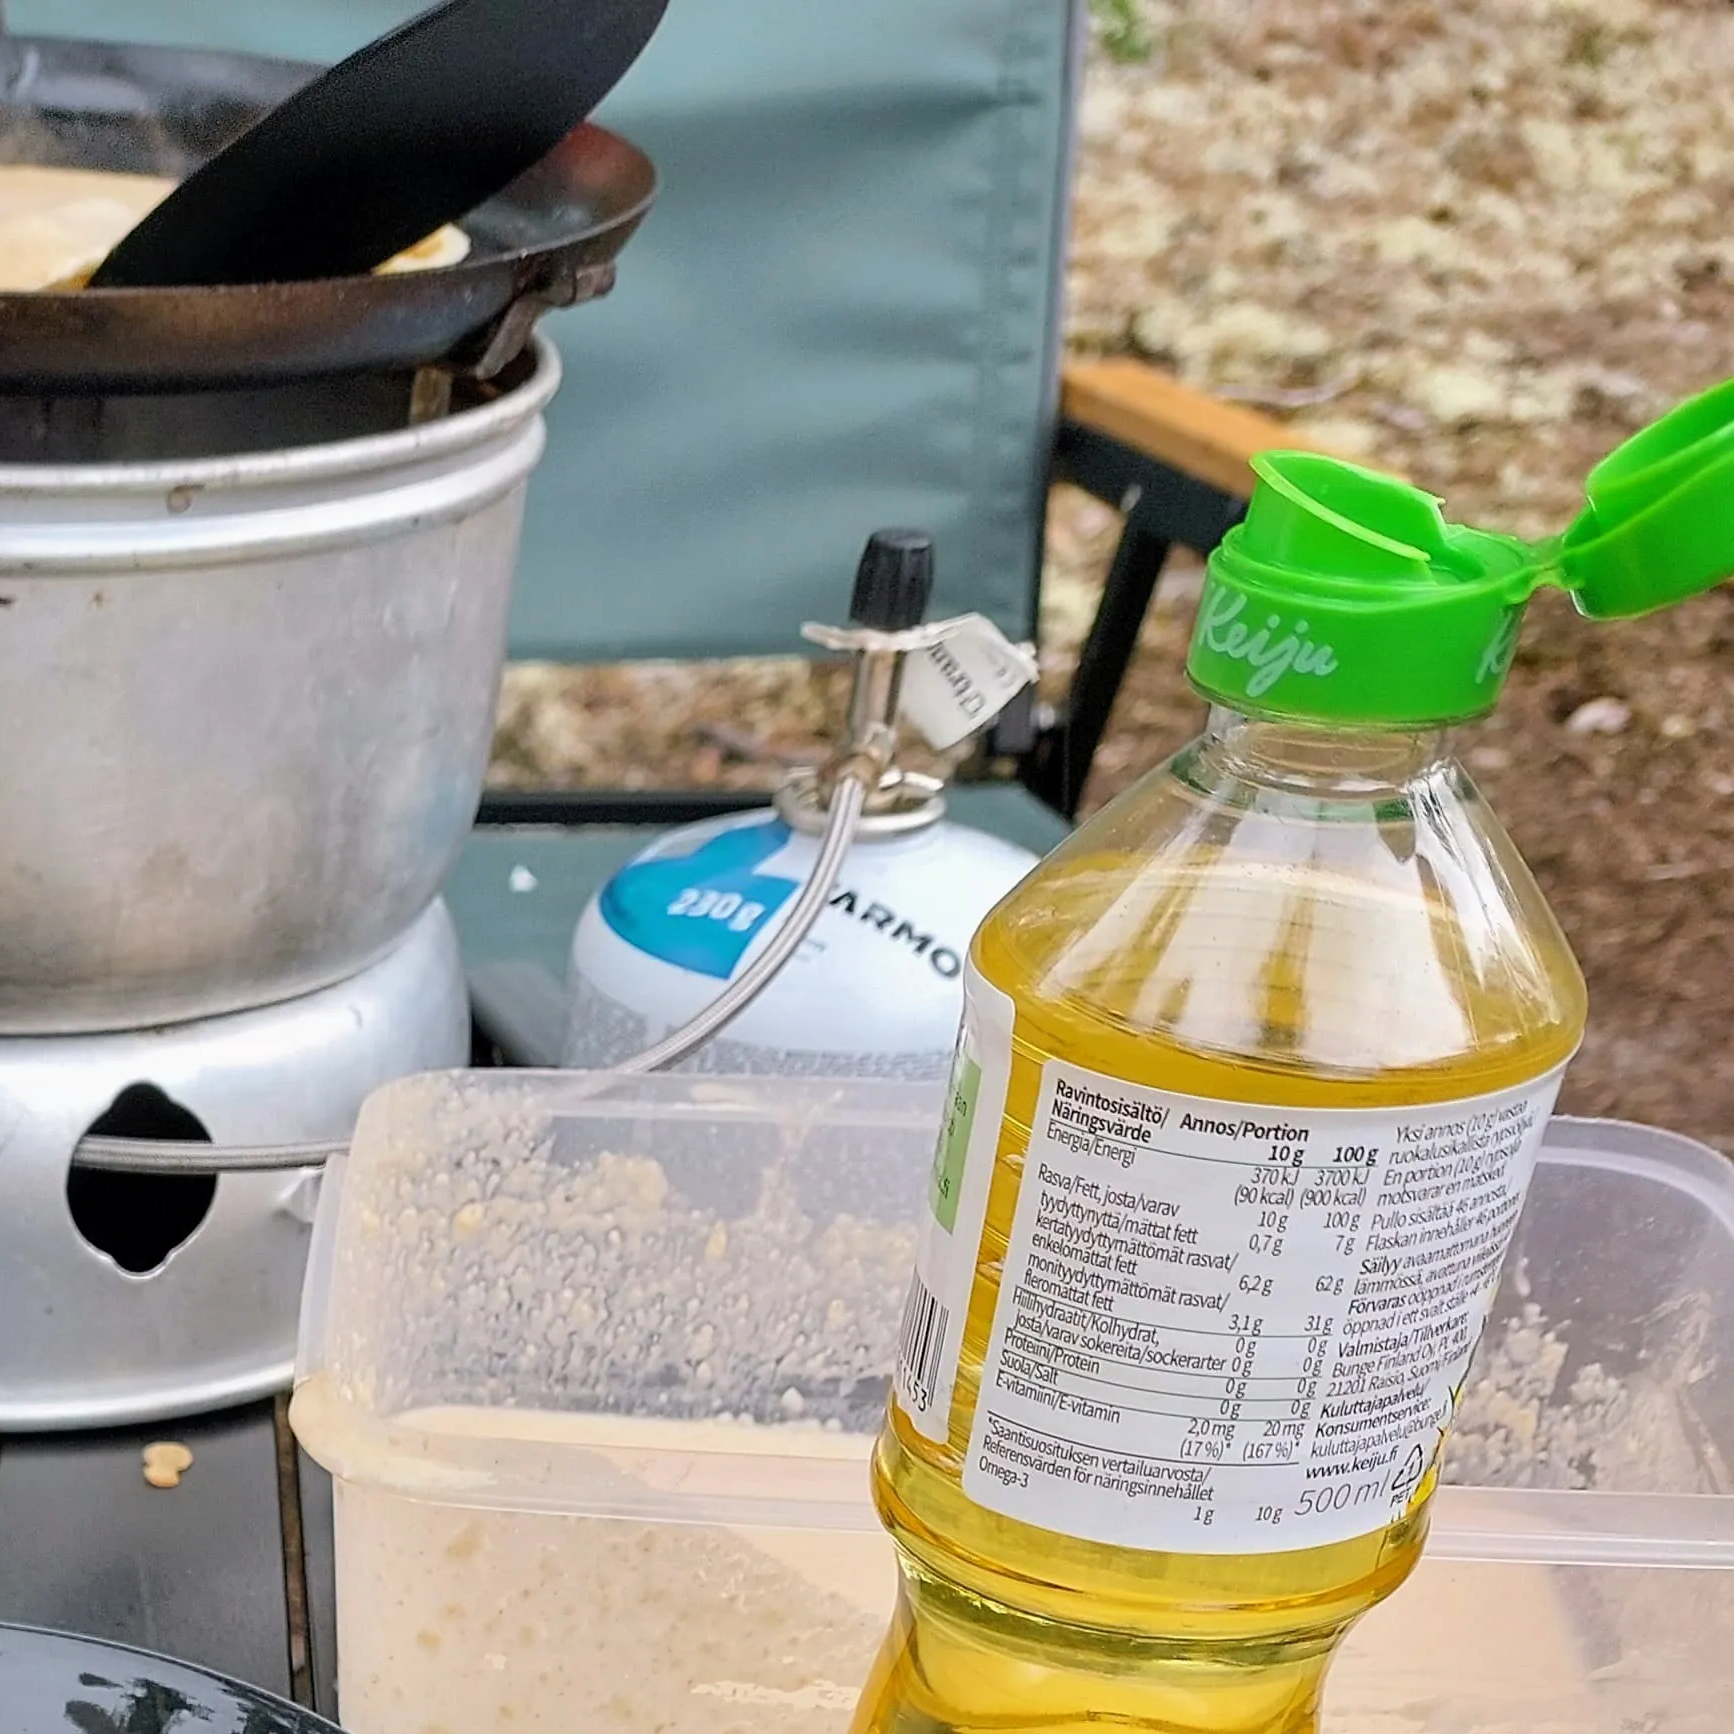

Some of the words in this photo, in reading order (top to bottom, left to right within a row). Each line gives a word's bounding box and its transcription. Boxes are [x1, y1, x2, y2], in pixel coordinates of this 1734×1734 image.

[1198, 584, 1338, 698] Keiju
[667, 886, 766, 933] 230g
[830, 884, 962, 980] ARMO
[1051, 1099, 1152, 1144] Näringsvärde
[1055, 1079, 1170, 1128] Ravintosisältö/
[1179, 1112, 1310, 1143] Annos/Portion
[1046, 1121, 1136, 1170] Energia/Energi
[1267, 1145, 1290, 1163] 10
[1290, 1149, 1305, 1168] g
[1332, 1146, 1365, 1164] 100
[1365, 1148, 1379, 1168] g
[1250, 1167, 1275, 1186] 370
[1314, 1168, 1349, 1187] 3700
[1037, 1162, 1102, 1203] Rasva/Fett,
[1101, 1180, 1181, 1219] josta/varav
[1233, 1184, 1259, 1207] (90
[1260, 1184, 1294, 1207] kcal)
[1300, 1184, 1330, 1207] (900
[1330, 1184, 1367, 1206] kcal)
[1257, 1211, 1277, 1229] 10
[1277, 1214, 1289, 1233] g
[1322, 1210, 1349, 1229] 100
[1349, 1214, 1361, 1233] g
[1173, 1226, 1200, 1245] fett
[1248, 1232, 1269, 1252] 0,7
[1271, 1237, 1284, 1256] g
[1335, 1234, 1344, 1252] 7
[1344, 1237, 1356, 1256] g
[1114, 1256, 1140, 1277] fett
[1186, 1251, 1239, 1273] rasvat/
[1358, 1255, 1403, 1277] Säilyy
[1238, 1275, 1261, 1295] 6,2
[1261, 1279, 1275, 1297] g
[1315, 1275, 1333, 1292] 62
[1333, 1279, 1345, 1298] g
[1090, 1292, 1116, 1313] fett
[1176, 1292, 1230, 1313] rasvat/
[1348, 1293, 1408, 1316] Förvaras
[1228, 1315, 1249, 1333] 3,1
[1250, 1318, 1264, 1336] g
[1304, 1315, 1322, 1332] 31
[1322, 1318, 1334, 1336] g
[1246, 1341, 1257, 1359] g
[1317, 1340, 1328, 1358] g
[1003, 1327, 1100, 1375] Proteiini/Protein
[1236, 1380, 1247, 1399] g
[1306, 1380, 1317, 1398] g
[1242, 1359, 1253, 1378] g
[1312, 1359, 1323, 1377] g
[1332, 1359, 1376, 1381] Bunge
[999, 1348, 1059, 1386] Suola/Salt
[1230, 1402, 1242, 1421] g
[1300, 1402, 1311, 1420] g
[1325, 1377, 1367, 1399] 21201
[995, 1369, 1122, 1424] E-vitamiini/E-vitamin
[1187, 1417, 1210, 1437] 2,0
[1210, 1421, 1235, 1441] mg
[1262, 1418, 1281, 1437] 20
[1281, 1422, 1306, 1441] mg
[1179, 1438, 1202, 1459] (17
[1242, 1440, 1275, 1461] (167
[978, 1457, 1030, 1488] Omega-3
[982, 1435, 1071, 1481] Referensvärden
[1072, 1464, 1093, 1485] för
[1092, 1473, 1215, 1502] näringsinnehållet
[1101, 1456, 1213, 1484] vertailuarvosta/
[1305, 1444, 1400, 1480] www.keiju.fi
[1294, 1482, 1352, 1517] 500
[1353, 1469, 1391, 1506] ml
[1201, 1508, 1215, 1526] g
[1254, 1505, 1272, 1522] 10
[1272, 1508, 1284, 1526] g
